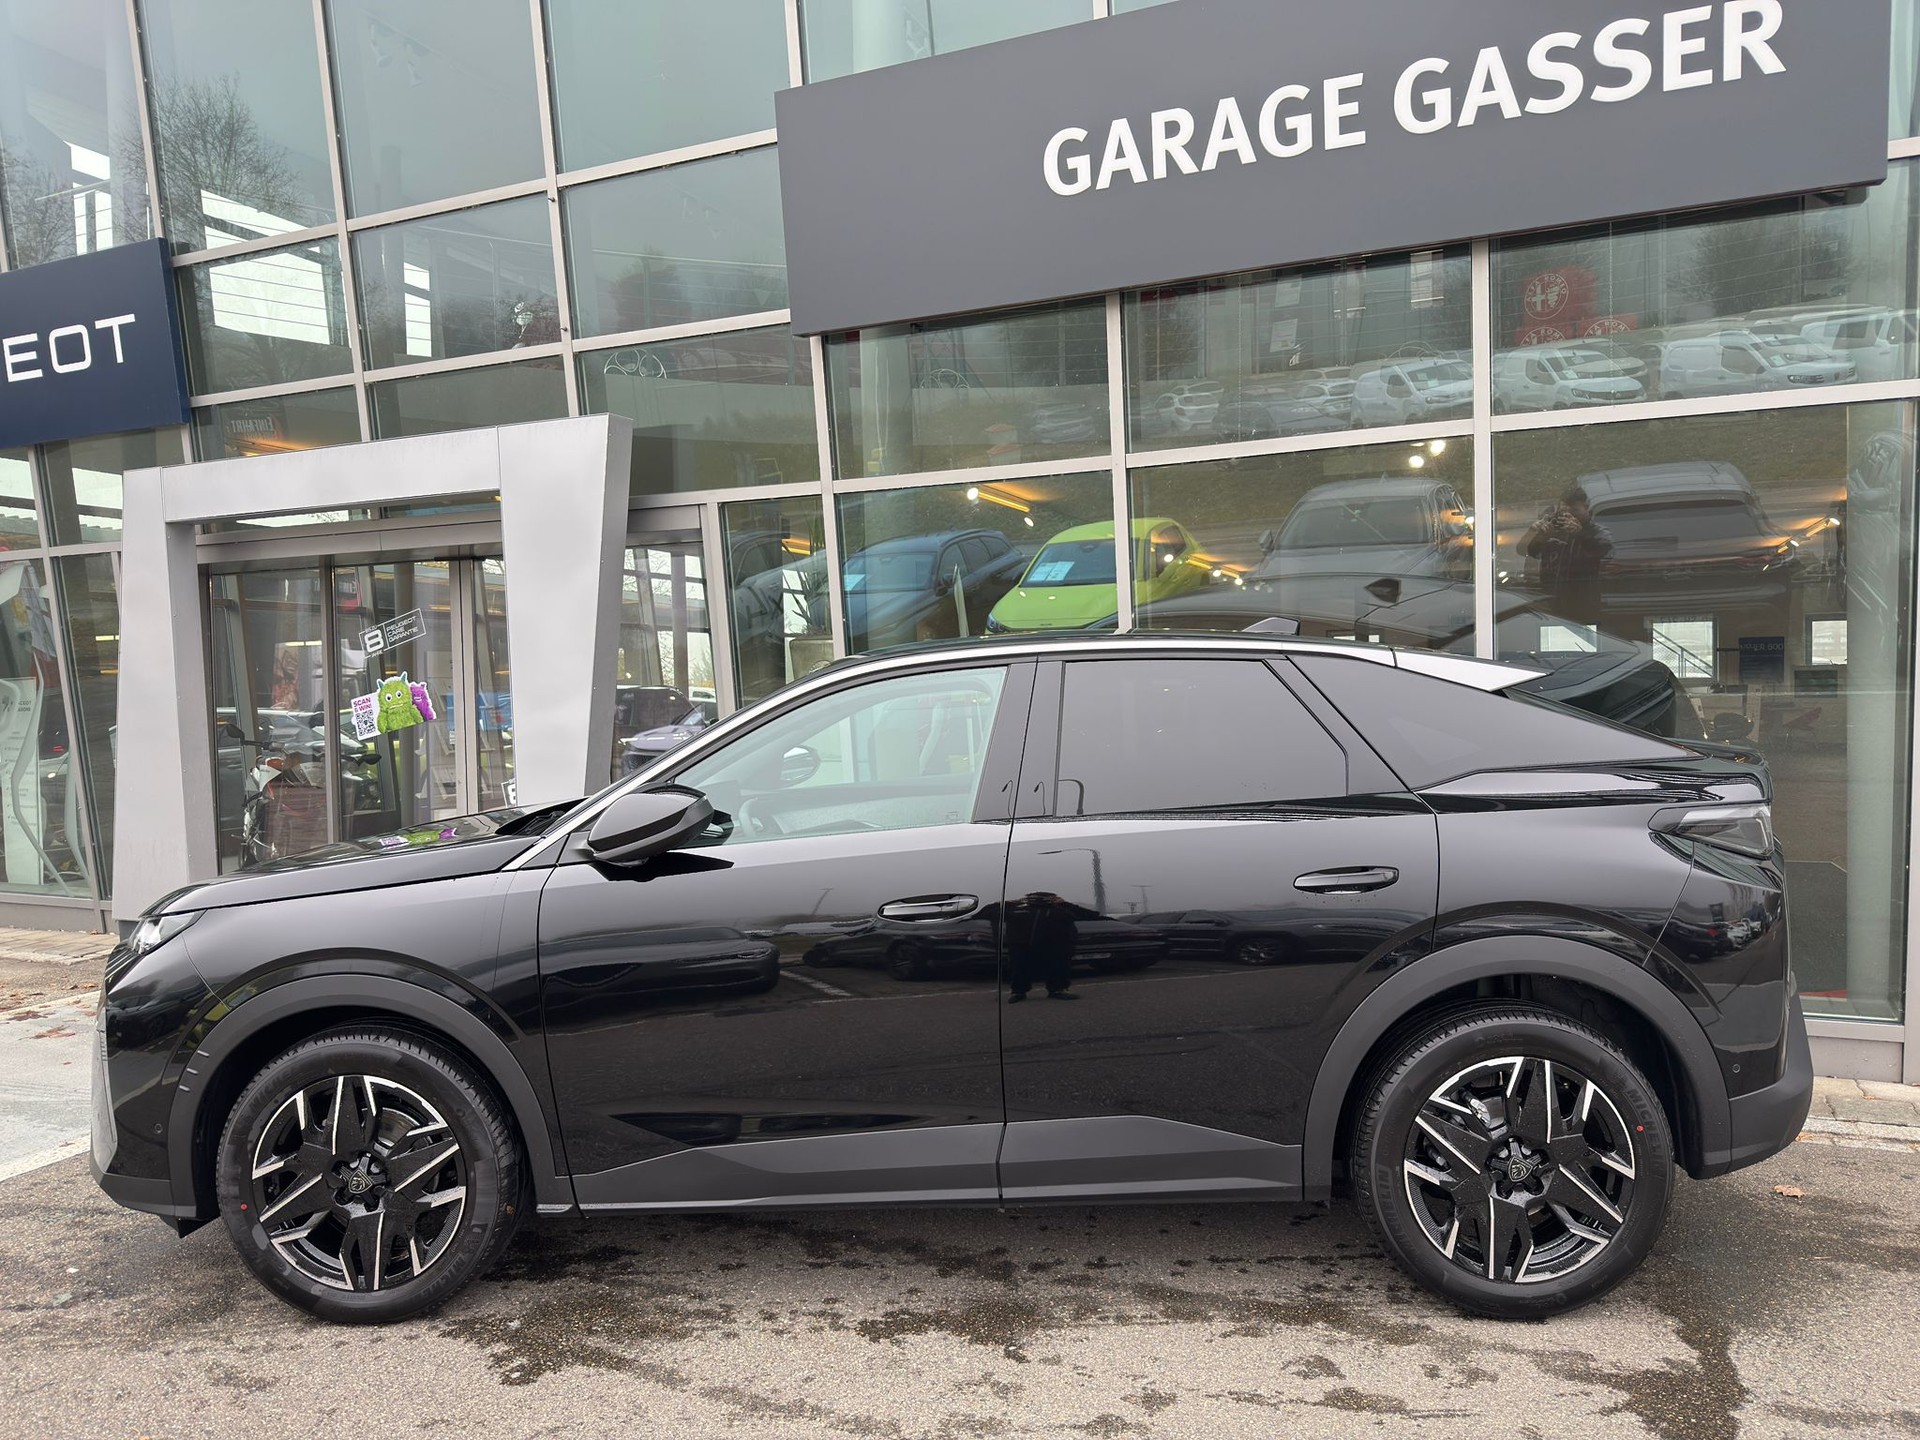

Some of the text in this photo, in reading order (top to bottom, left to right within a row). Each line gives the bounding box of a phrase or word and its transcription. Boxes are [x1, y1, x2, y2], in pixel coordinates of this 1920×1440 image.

[1043, 0, 1787, 196] GARAGE GASSER
[2, 313, 136, 382] EOT
[386, 616, 417, 632] PEUGEOT
[387, 626, 405, 637] CARE
[364, 629, 384, 653] 8
[389, 627, 419, 643] GARANTIE
[353, 697, 371, 707] SCAN
